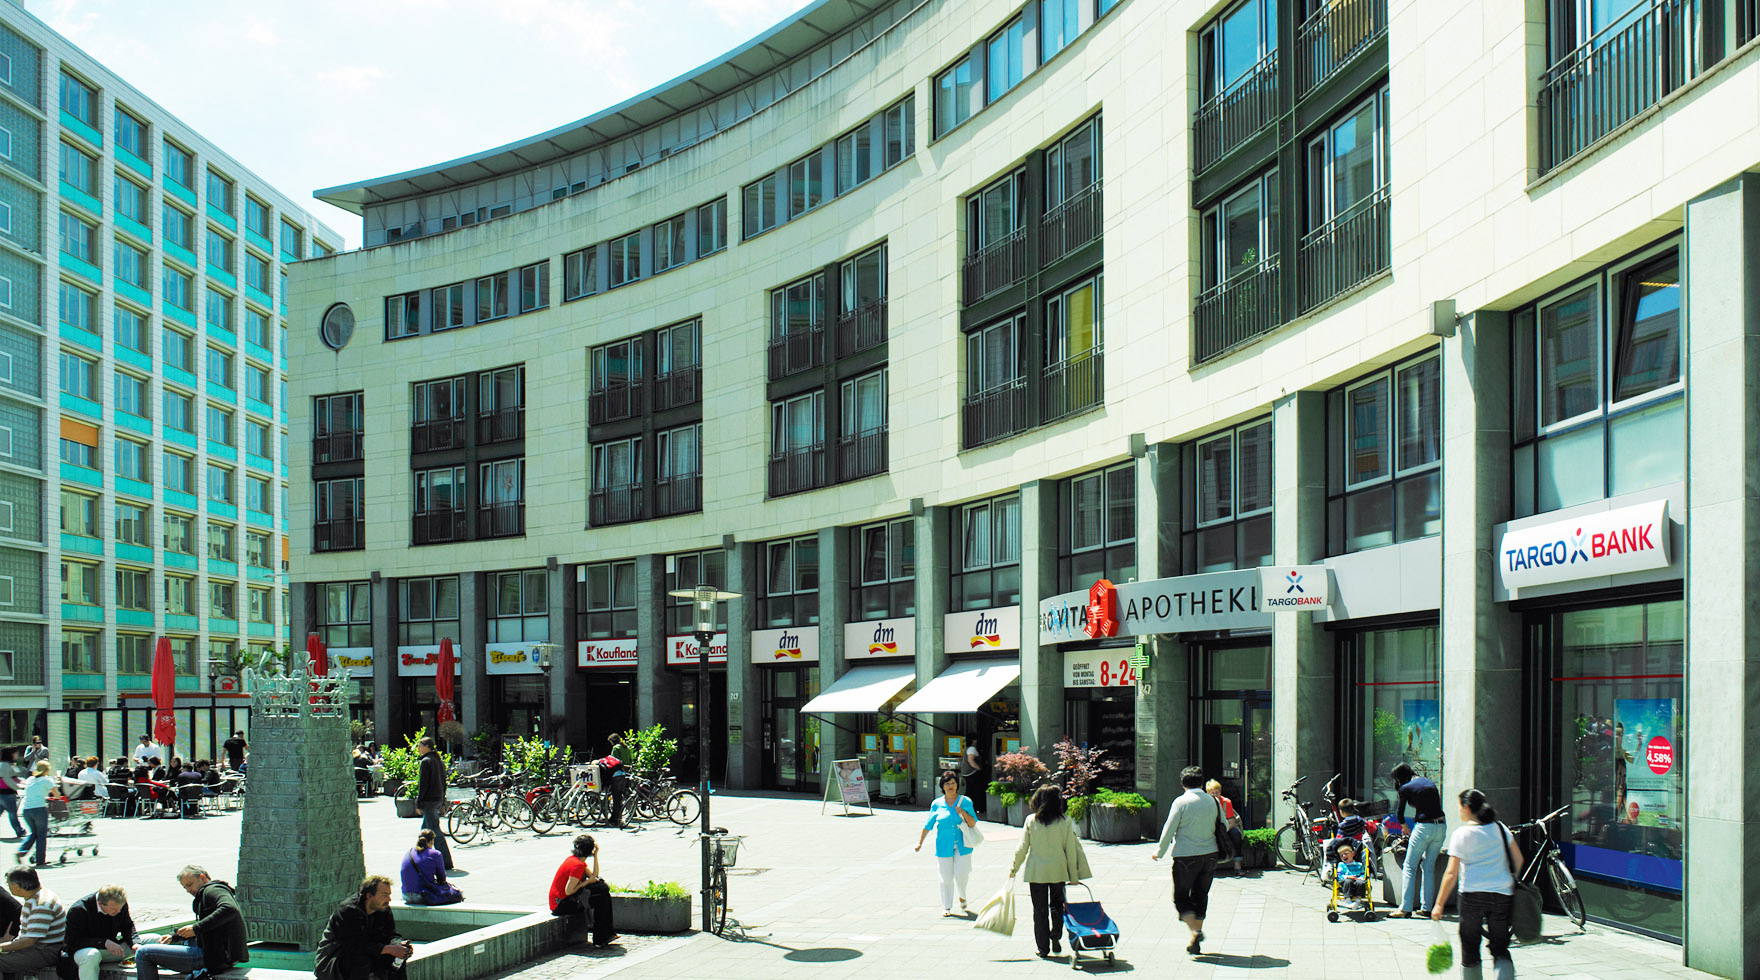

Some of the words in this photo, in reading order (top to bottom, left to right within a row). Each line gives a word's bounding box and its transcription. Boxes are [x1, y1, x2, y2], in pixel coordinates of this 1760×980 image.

[1505, 540, 1567, 572] TARGO
[1591, 523, 1655, 559] BANK
[1267, 595, 1322, 607] TARGOBANK
[873, 622, 895, 643] dm
[975, 612, 998, 636] dm
[778, 630, 799, 650] dm
[596, 645, 638, 660] Kaufland
